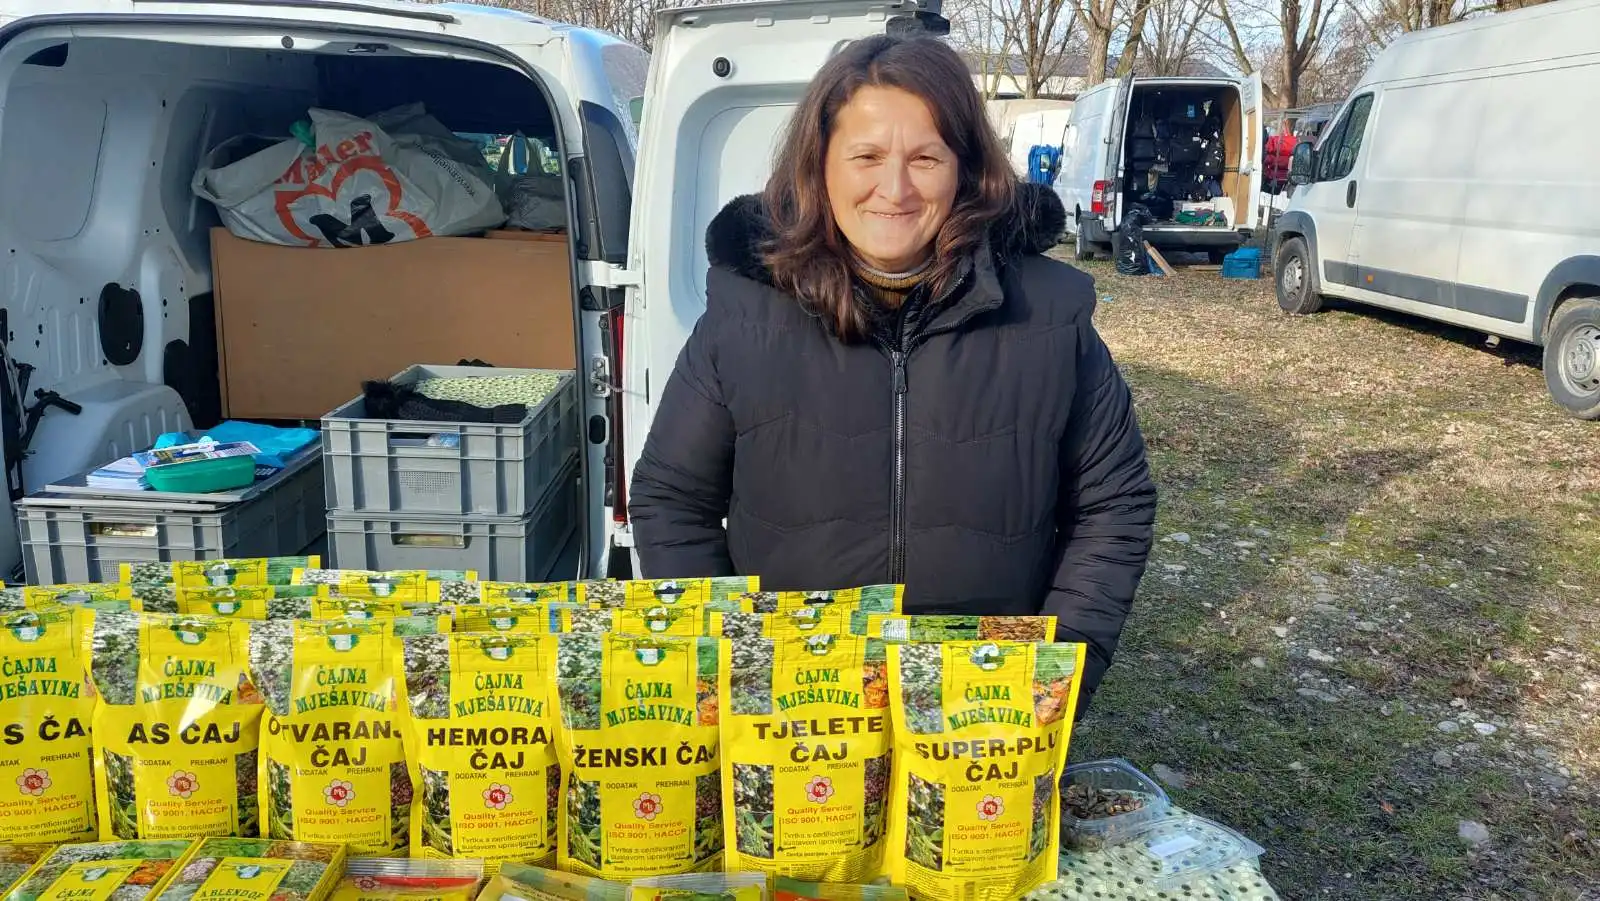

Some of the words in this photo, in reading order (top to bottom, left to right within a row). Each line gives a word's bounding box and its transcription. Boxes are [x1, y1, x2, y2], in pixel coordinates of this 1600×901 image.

[3, 656, 57, 677] ČAJNA
[164, 656, 216, 677] ČAJNA
[317, 665, 367, 686] ČAJNA
[796, 667, 840, 685] ČAJNA
[0, 675, 80, 701] EŠAVINA
[475, 671, 523, 691] ČAJNA
[625, 679, 673, 700] ČAJNA
[296, 685, 388, 713] MJEŠAVINA
[776, 685, 860, 711] MJEŠAVINA
[965, 682, 1011, 703] ČAJNA
[454, 690, 544, 718] MJEŠAVINA
[605, 698, 694, 728] MJEŠAVINA
[948, 702, 1031, 731] MJEŠAVINA
[39, 715, 92, 741] ČA
[127, 722, 170, 744] AS
[427, 726, 553, 746] HEMORA
[753, 716, 883, 740] TJELETE
[0, 759, 20, 767] ATAK
[40, 752, 81, 763] PREHRANI
[190, 758, 228, 766] PREHRANI
[310, 745, 367, 768] ČAJ
[470, 748, 525, 770] ČAJ
[573, 745, 667, 768] ŽENSKI
[790, 742, 848, 763] ČAJ
[346, 766, 383, 775] PREHRANI
[505, 770, 540, 778] PREHRANI
[779, 765, 809, 773] DODATAK
[826, 762, 859, 770] PREHRANI
[966, 760, 1018, 782] ČAJ
[656, 780, 690, 788] PREHRANI
[951, 784, 982, 792] DODATAK
[38, 794, 77, 804] Service
[149, 800, 181, 809] Quality
[185, 798, 222, 807] Service
[305, 808, 337, 816] Quality
[340, 807, 376, 815] Service
[463, 813, 496, 821] Quality
[499, 810, 535, 818] Service
[787, 806, 818, 815] Quality
[820, 804, 853, 813] Service
[504, 818, 539, 828] HACCP
[614, 822, 646, 830] Quality
[648, 821, 683, 829] Service
[654, 828, 688, 838] HACCP
[957, 824, 988, 832] Quality
[991, 822, 1021, 830] Service
[0, 831, 36, 840] ustavom
